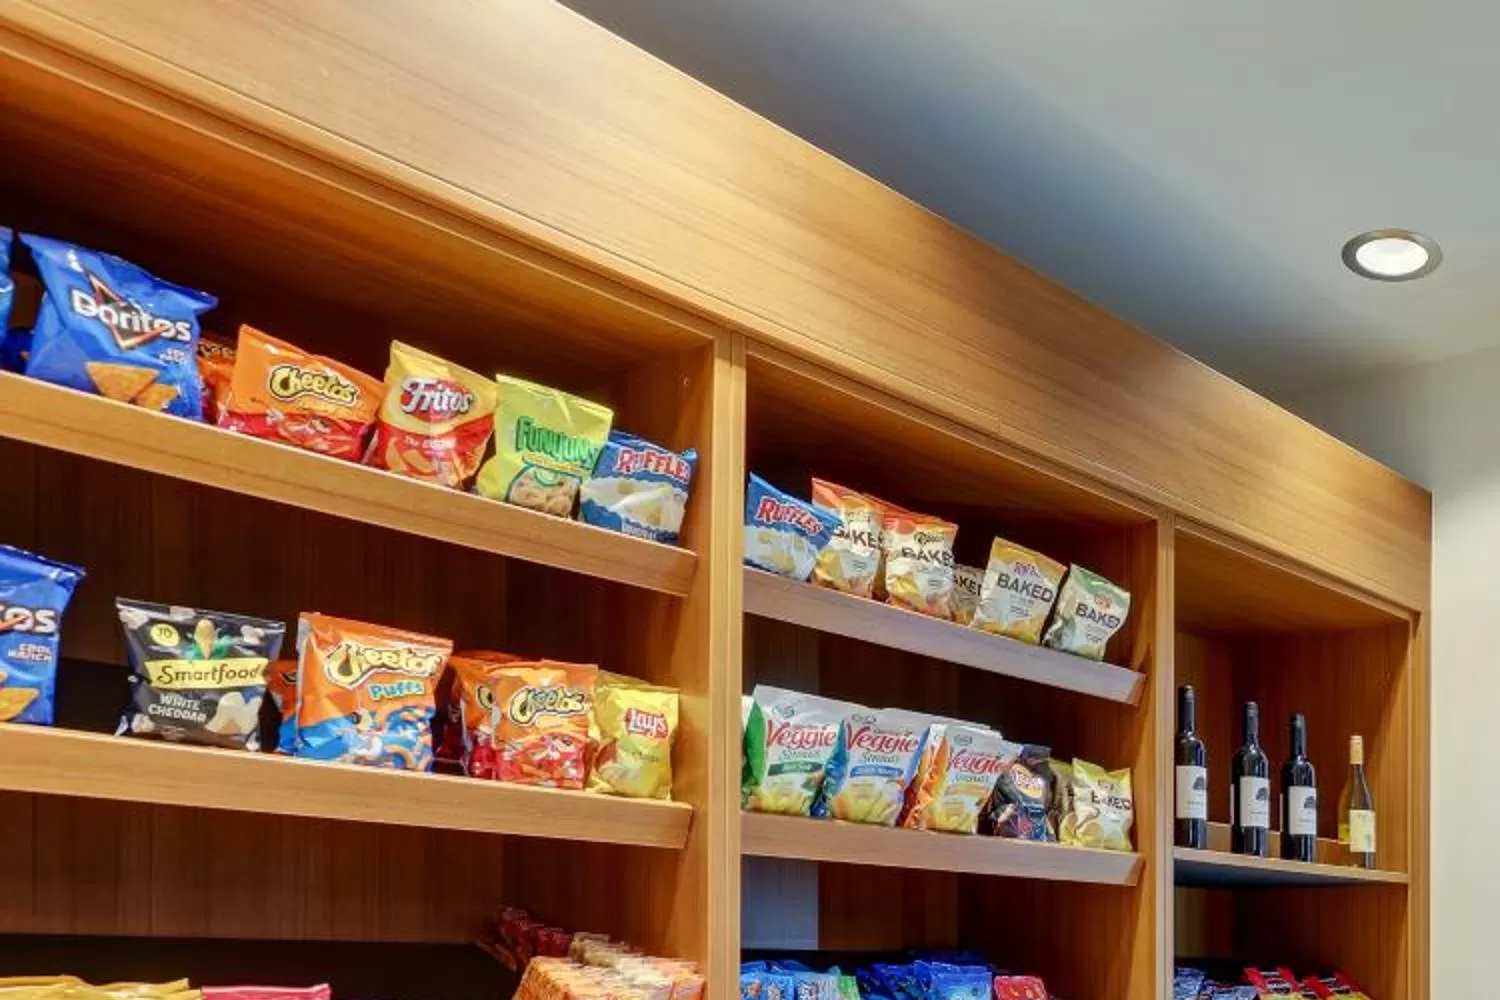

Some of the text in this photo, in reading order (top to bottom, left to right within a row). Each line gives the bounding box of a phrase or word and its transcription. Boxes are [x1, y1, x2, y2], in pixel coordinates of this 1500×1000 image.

[70, 287, 193, 342] Doritos
[269, 365, 358, 404] Cheetos
[400, 377, 473, 414] Fritos
[952, 574, 983, 597] AKE
[998, 573, 1054, 603] BAKED
[156, 665, 262, 685] Smartfood
[326, 641, 443, 688] Cheetos
[508, 686, 588, 725] Cheetos
[767, 720, 837, 749] Veggie
[846, 720, 919, 753] Veggie
